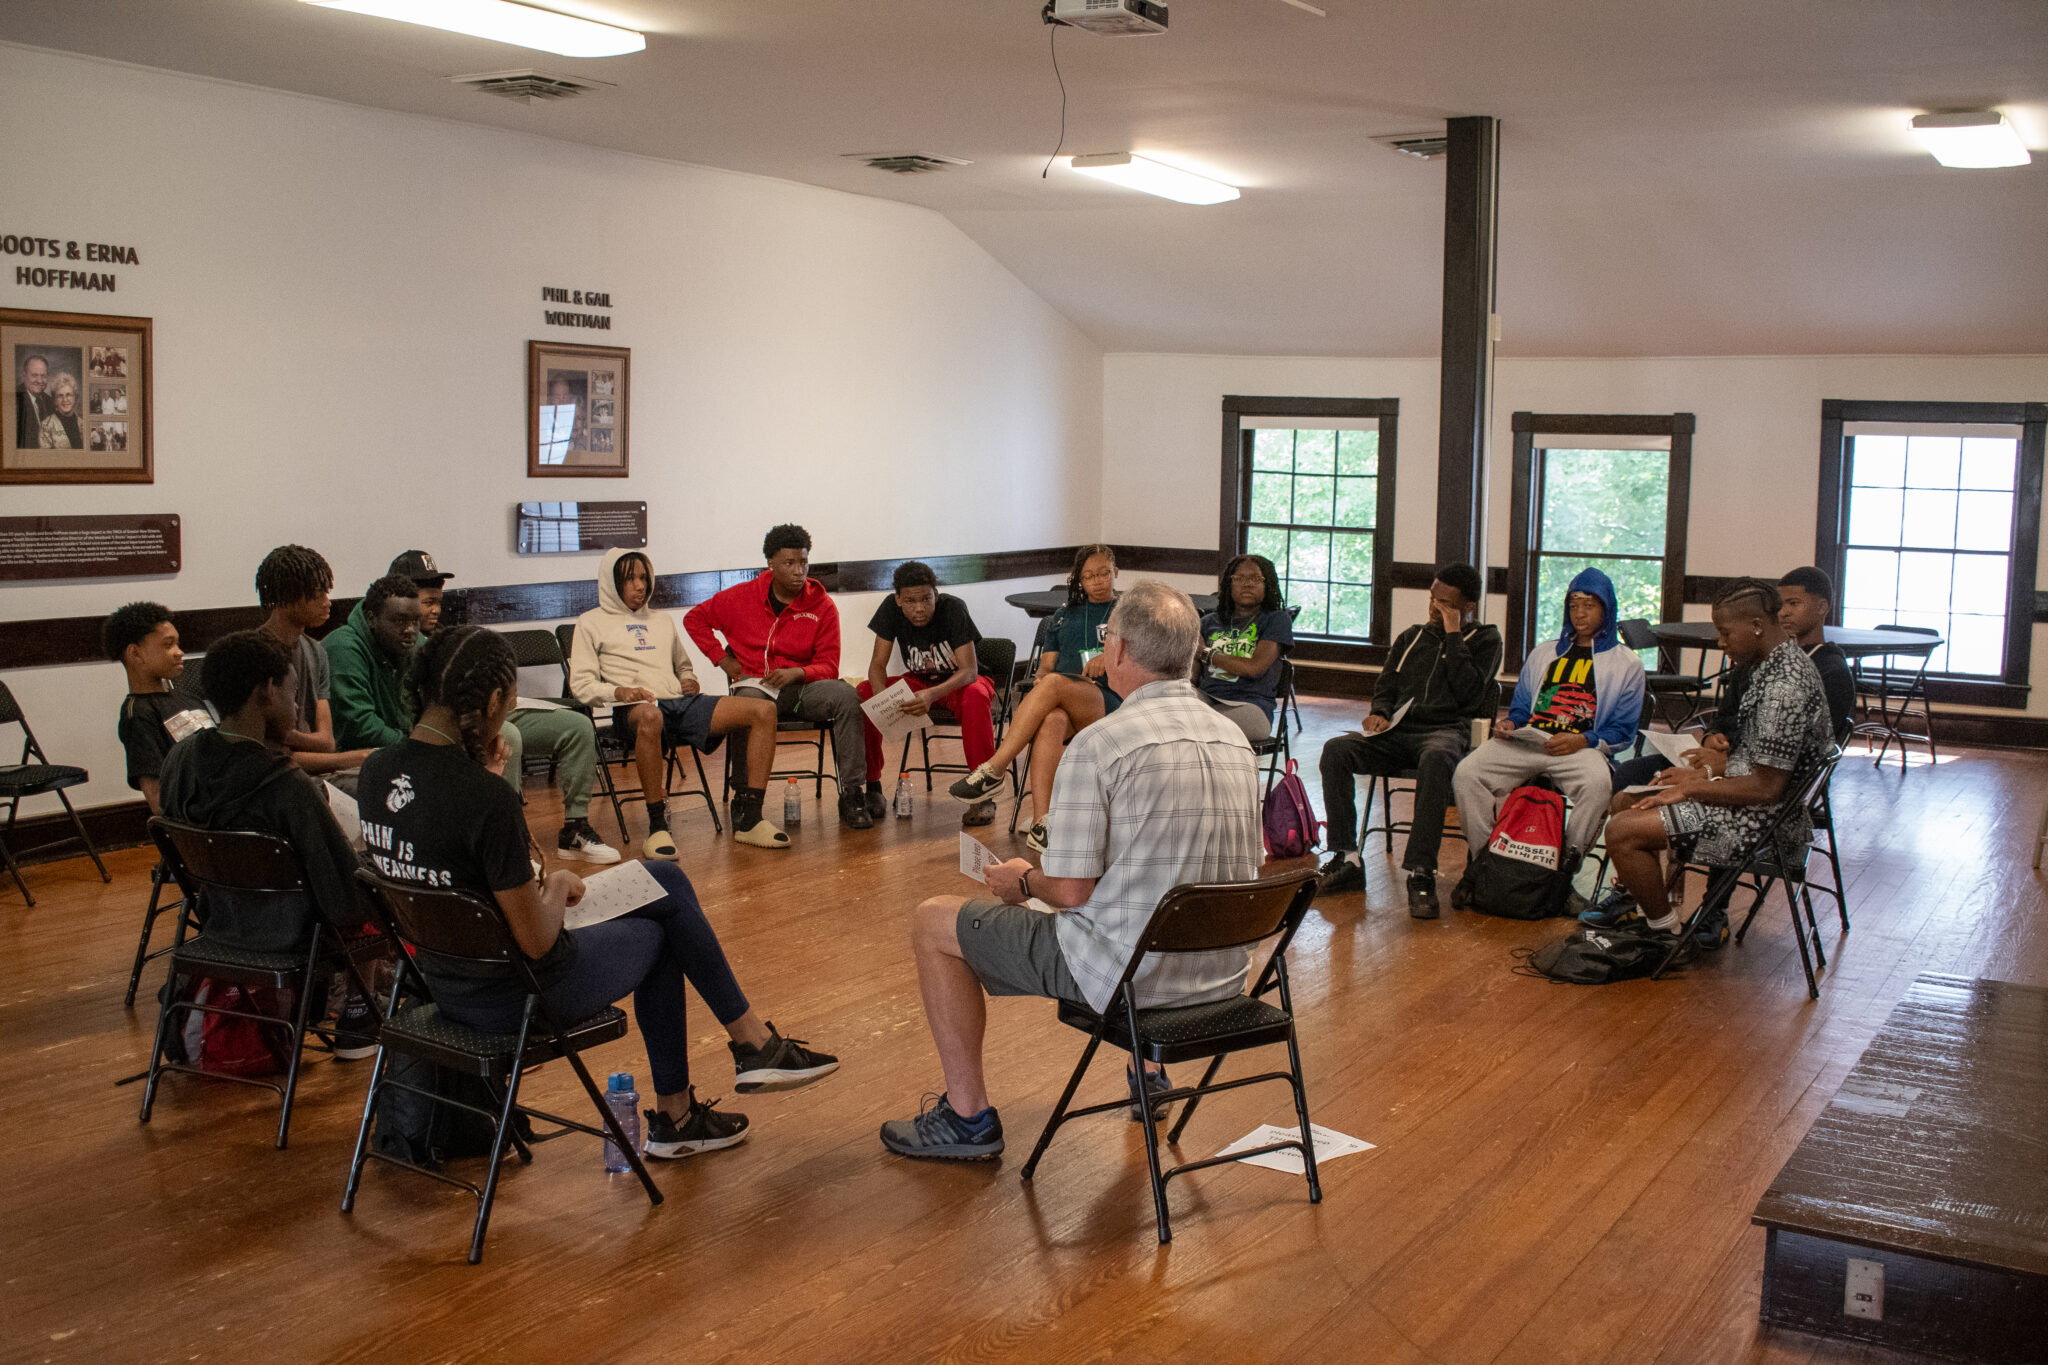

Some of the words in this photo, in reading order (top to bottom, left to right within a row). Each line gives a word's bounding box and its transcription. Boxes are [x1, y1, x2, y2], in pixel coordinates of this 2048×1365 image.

[0, 234, 61, 259] OOTS
[66, 240, 81, 260] &
[86, 242, 140, 266] ERNA
[16, 266, 116, 292] HOFFMAN
[542, 286, 572, 304] PHIL
[573, 290, 583, 306] &
[585, 291, 613, 308] GAIL
[544, 310, 611, 330] WORTMAN
[1543, 657, 1593, 685] IN
[361, 819, 394, 851] PAIN
[398, 840, 414, 862] IS
[373, 853, 452, 887] WEAKNESS
